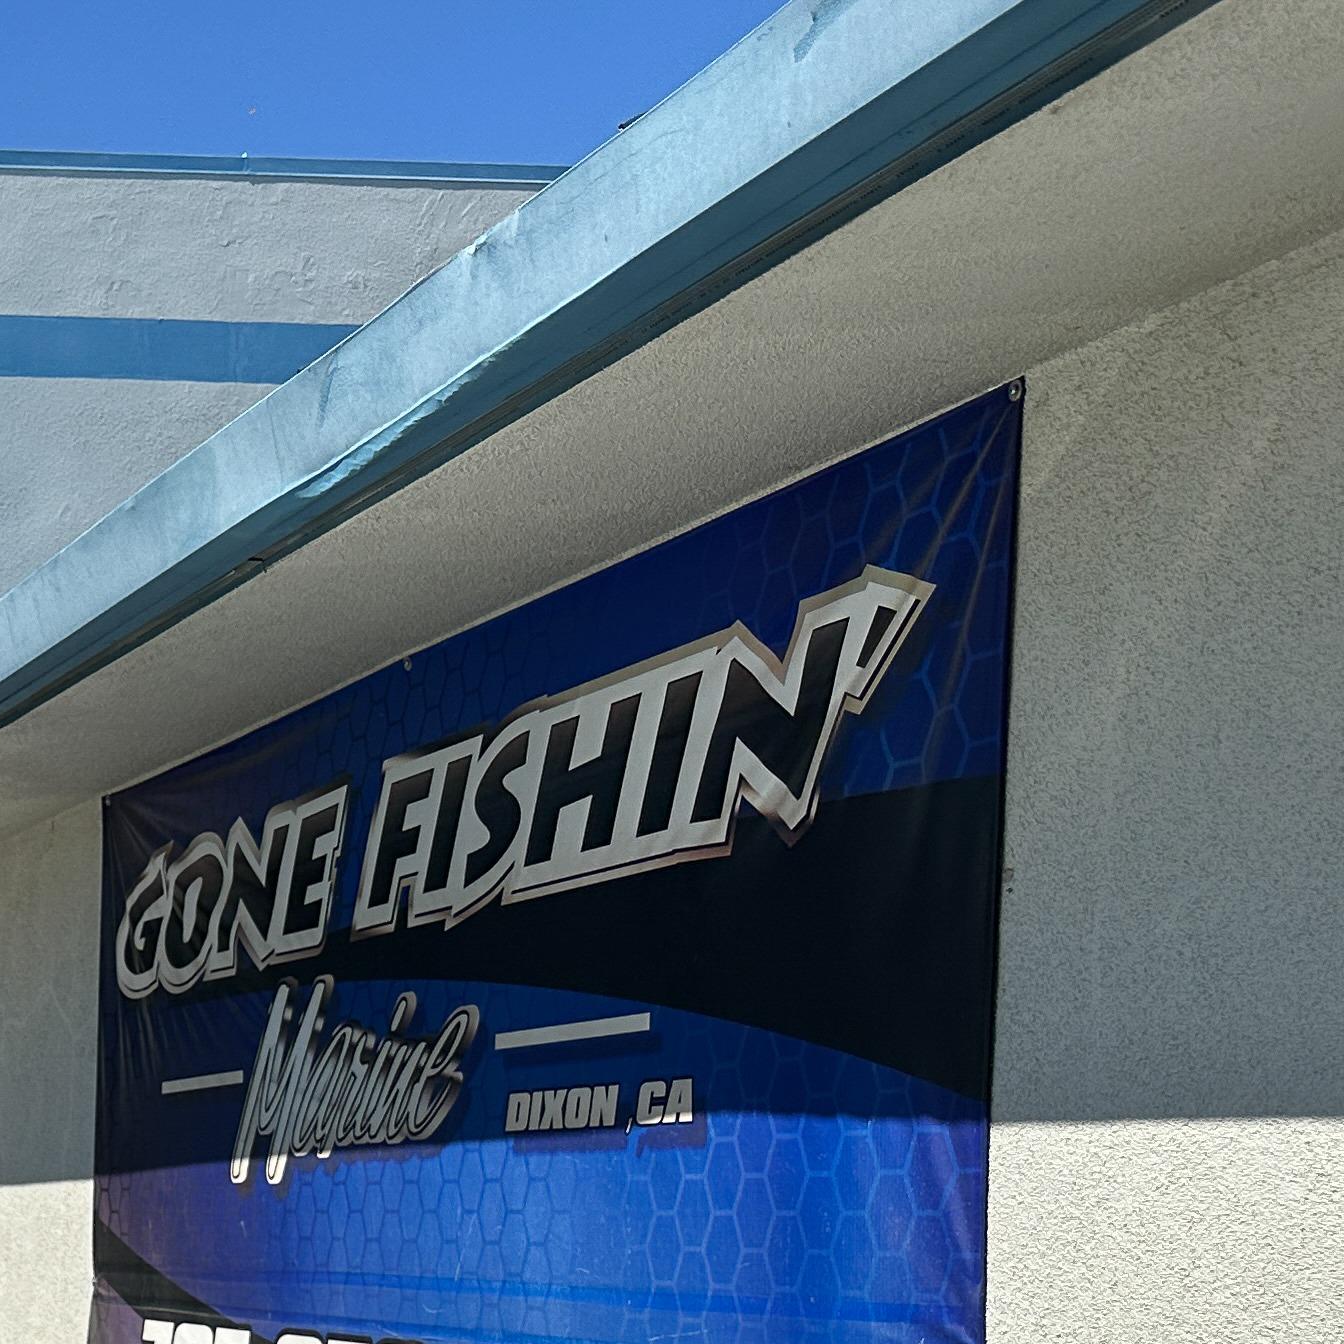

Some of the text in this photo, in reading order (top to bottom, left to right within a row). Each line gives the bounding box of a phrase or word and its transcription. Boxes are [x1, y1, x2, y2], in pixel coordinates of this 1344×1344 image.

[115, 564, 936, 998] GONE FISHIN'
[231, 976, 480, 1185] Marine
[505, 1083, 620, 1132] DIXON
